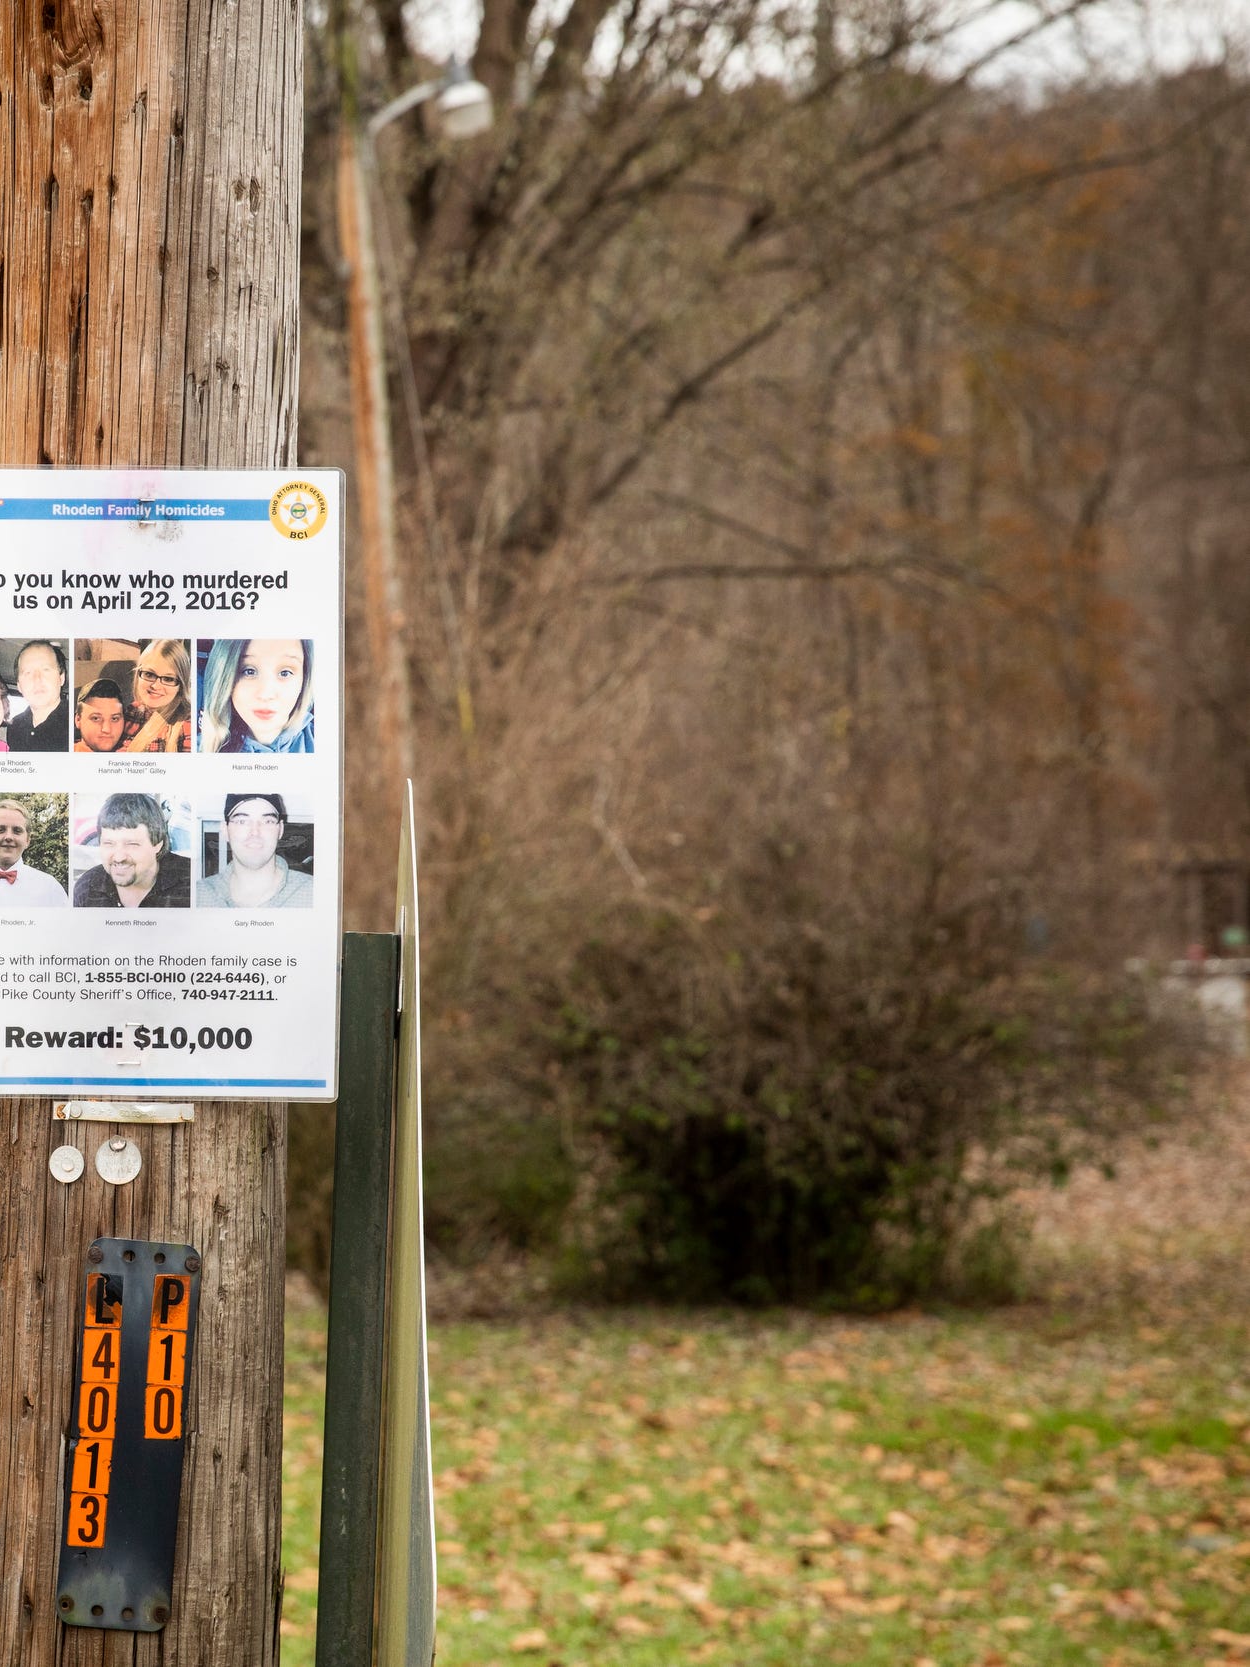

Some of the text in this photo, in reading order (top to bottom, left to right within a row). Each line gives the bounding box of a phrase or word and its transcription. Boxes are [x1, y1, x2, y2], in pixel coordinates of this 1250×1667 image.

[277, 484, 308, 499] ATTORNEY
[310, 488, 325, 514] GENERAL
[52, 504, 225, 519] Rhoden Family Homicides
[290, 531, 308, 539] BCI
[14, 574, 51, 592] you
[61, 570, 121, 588] know
[129, 570, 175, 589] who
[182, 571, 288, 589] murdered
[13, 590, 259, 614] us on April 22, 2016?
[1, 919, 27, 927] Rhoden,
[234, 920, 249, 928] Gary
[9, 955, 34, 965] with
[39, 955, 110, 966] information
[114, 956, 129, 965] on
[134, 955, 154, 966] the
[159, 955, 206, 966] Rhoden
[211, 956, 248, 968] family
[252, 957, 282, 966] case
[287, 956, 297, 966] is
[13, 973, 25, 982] to
[29, 972, 50, 983] call
[55, 972, 80, 984] BCI,
[85, 972, 186, 983] 1-855-BCI-OHIO
[190, 972, 269, 985] (224-6446),
[274, 975, 286, 983] or
[2, 989, 28, 999] Pike
[32, 989, 75, 1002] County
[80, 989, 132, 1000] Sheriff's
[137, 989, 176, 1001] Office,
[181, 990, 278, 1000] 740-947-2111.
[5, 1024, 253, 1054] Reward: $10,000
[153, 1278, 185, 1435] P10
